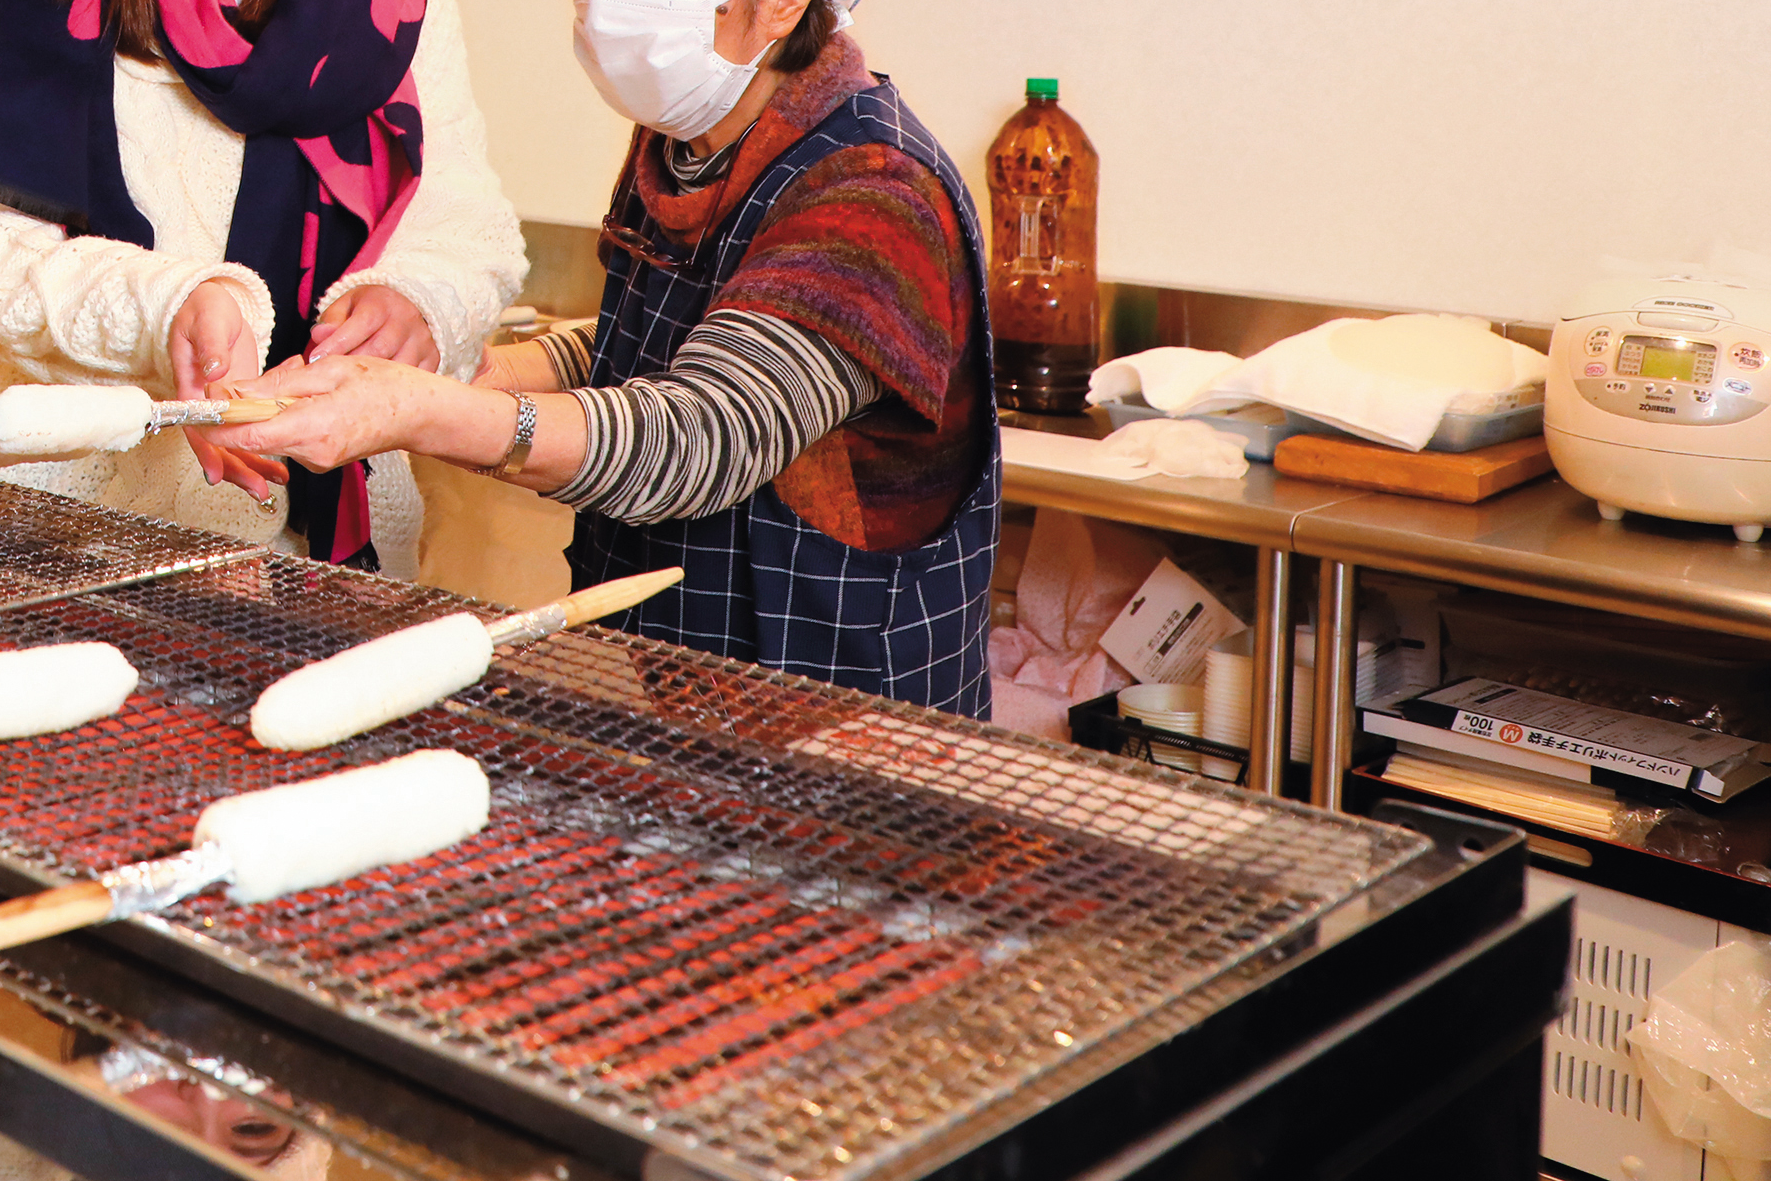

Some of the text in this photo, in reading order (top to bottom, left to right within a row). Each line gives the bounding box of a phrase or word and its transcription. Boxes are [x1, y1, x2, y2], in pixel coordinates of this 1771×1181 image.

[1740, 347, 1762, 359] 炊飯
[1639, 403, 1676, 415] ZOJIRUSHI
[1502, 728, 1520, 742] M
[1527, 730, 1680, 776] ハンドフィットポリエチ手袋
